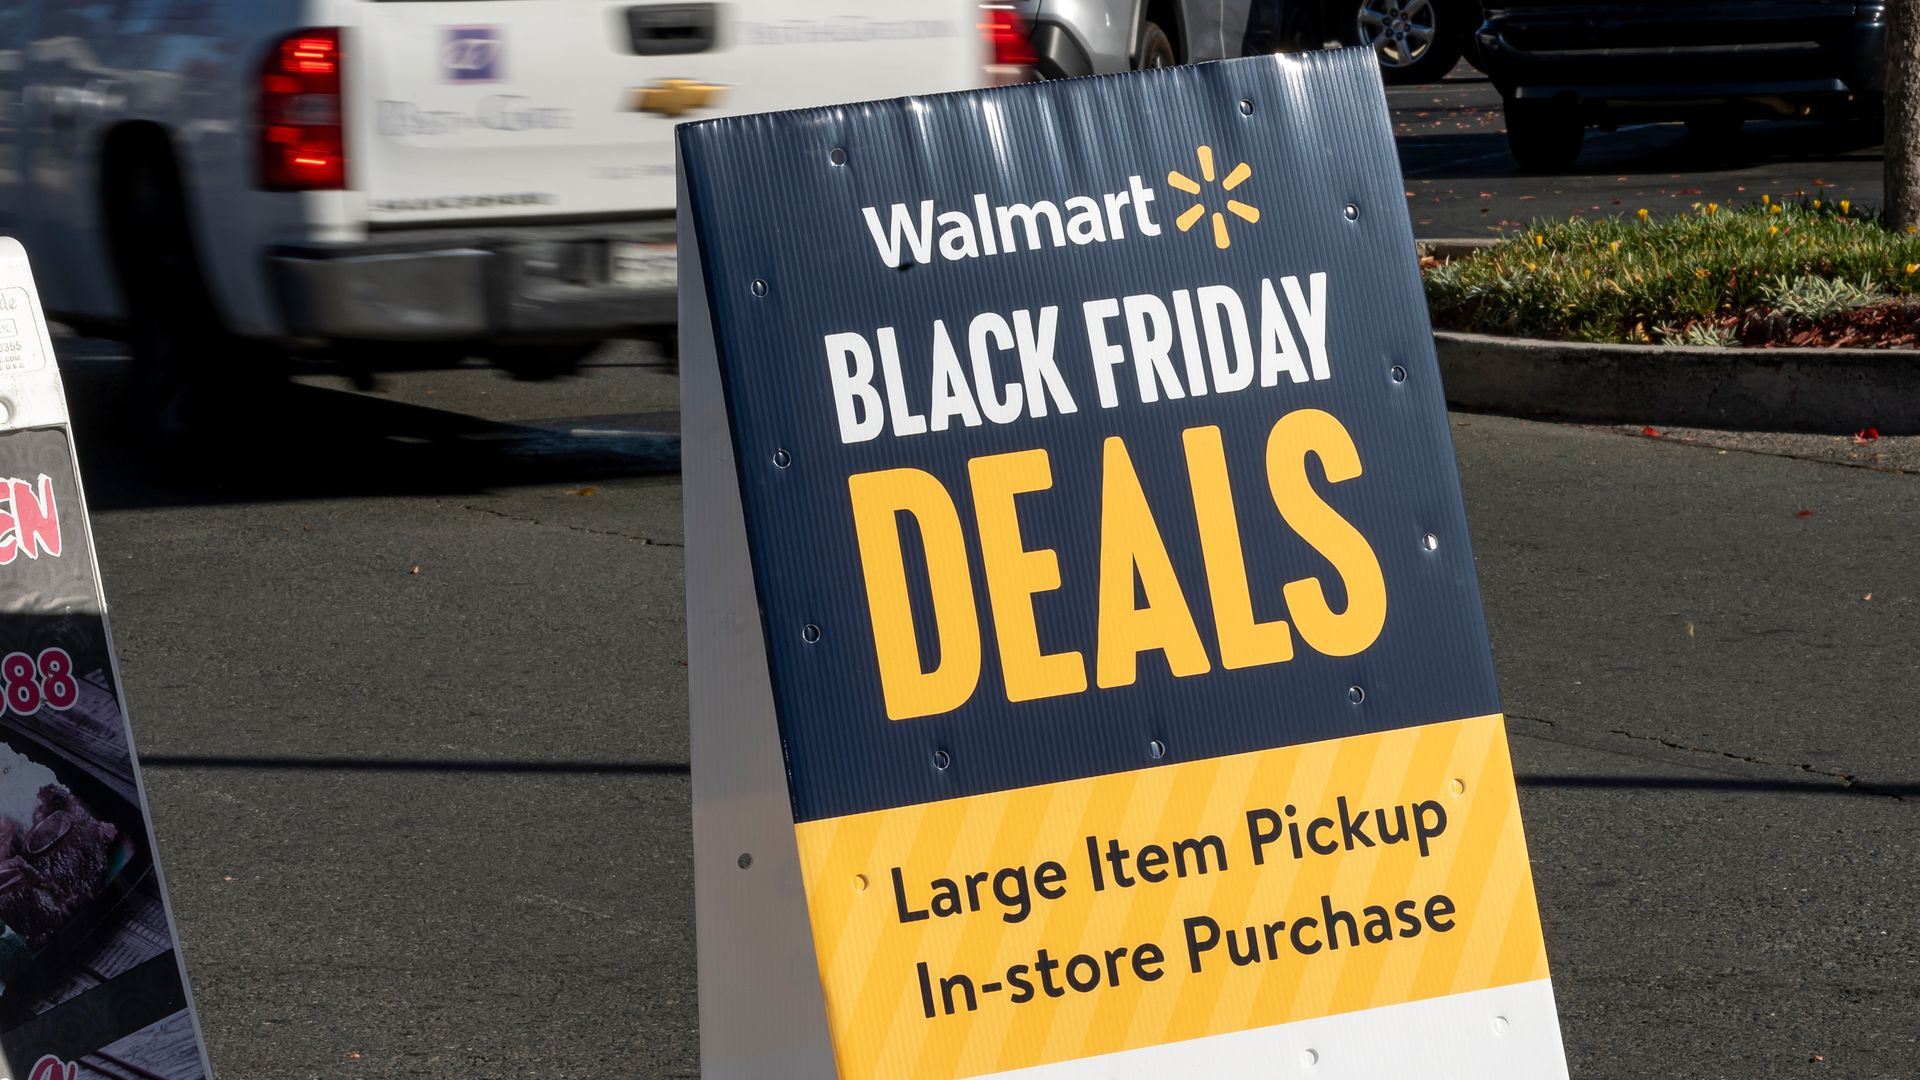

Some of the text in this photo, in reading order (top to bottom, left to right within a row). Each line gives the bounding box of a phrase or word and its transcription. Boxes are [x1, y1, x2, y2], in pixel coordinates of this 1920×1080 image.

[861, 173, 1162, 267] Walmart
[824, 271, 1331, 444] BLACK FRIDAY
[848, 408, 1387, 721] DEALS
[0, 646, 64, 718] 88
[891, 795, 1447, 924] Large Item Pickup
[916, 894, 1456, 1019] In-store Purchase
